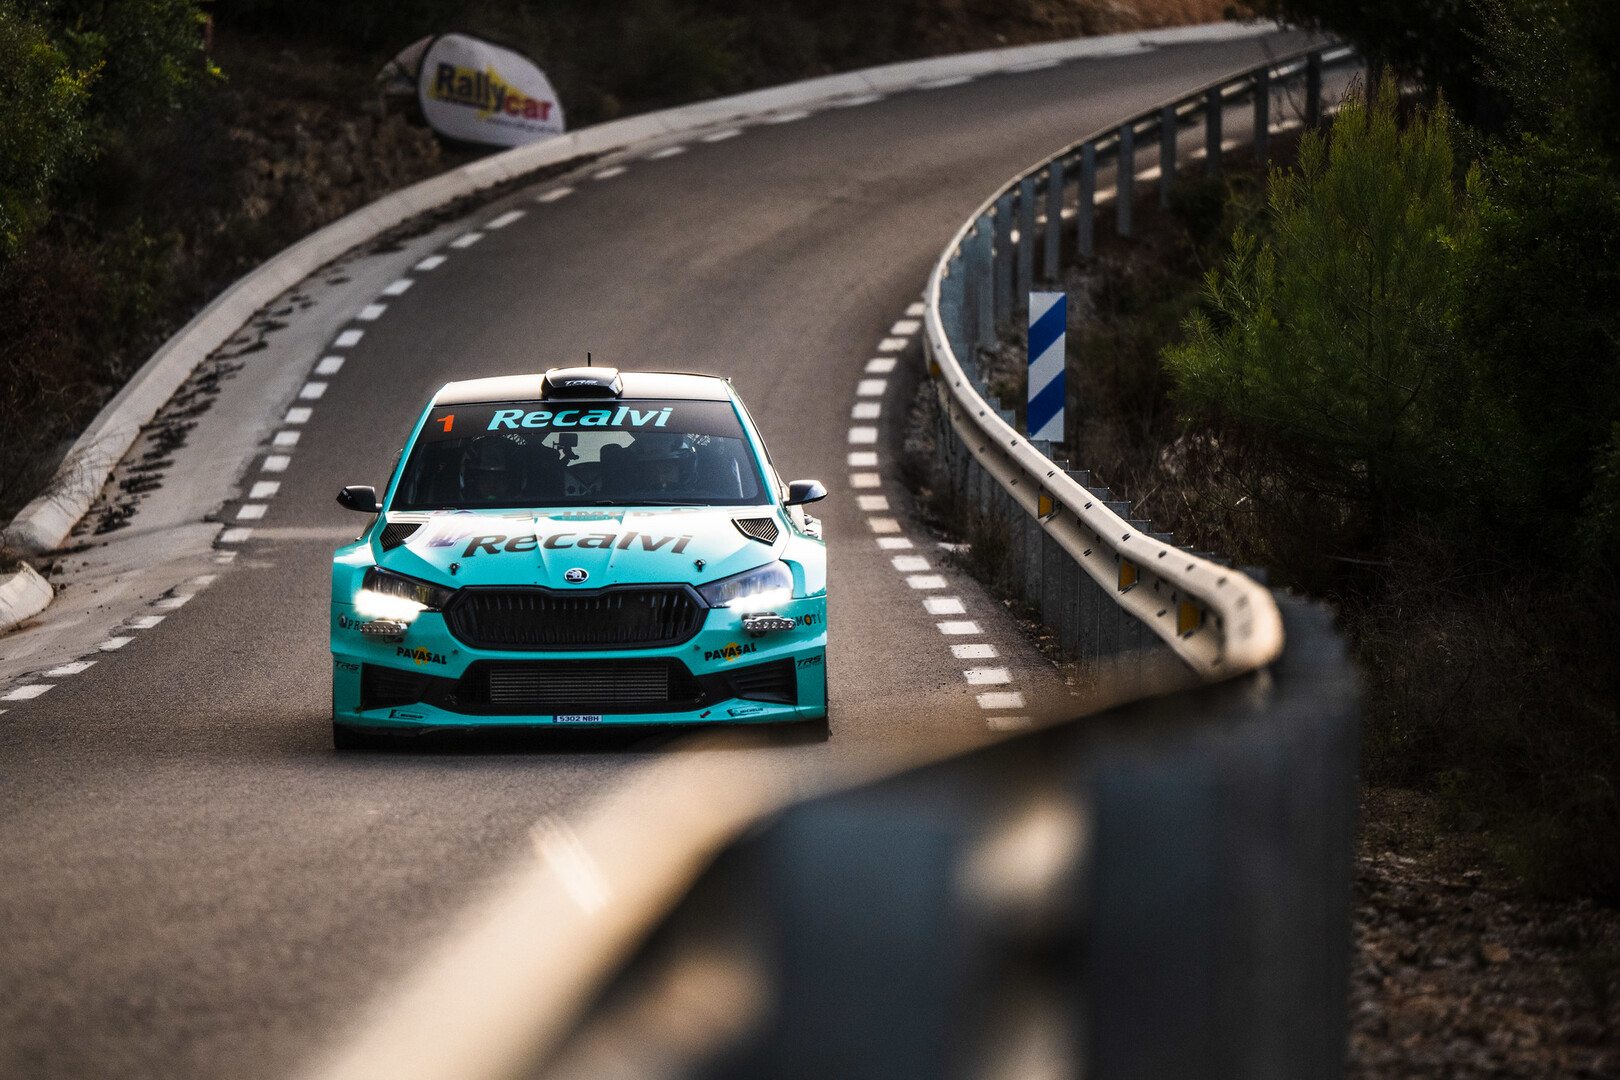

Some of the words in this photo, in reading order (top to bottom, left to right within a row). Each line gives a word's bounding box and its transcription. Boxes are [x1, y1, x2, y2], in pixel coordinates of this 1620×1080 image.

[436, 62, 552, 121] Rallycar
[437, 415, 454, 432] 1
[487, 406, 673, 431] Recalvi
[461, 531, 694, 558] Recalvi
[396, 646, 447, 664] PAVASAL
[704, 642, 757, 661] PAVASAL
[335, 661, 360, 671] TRS
[797, 655, 823, 667] TRS
